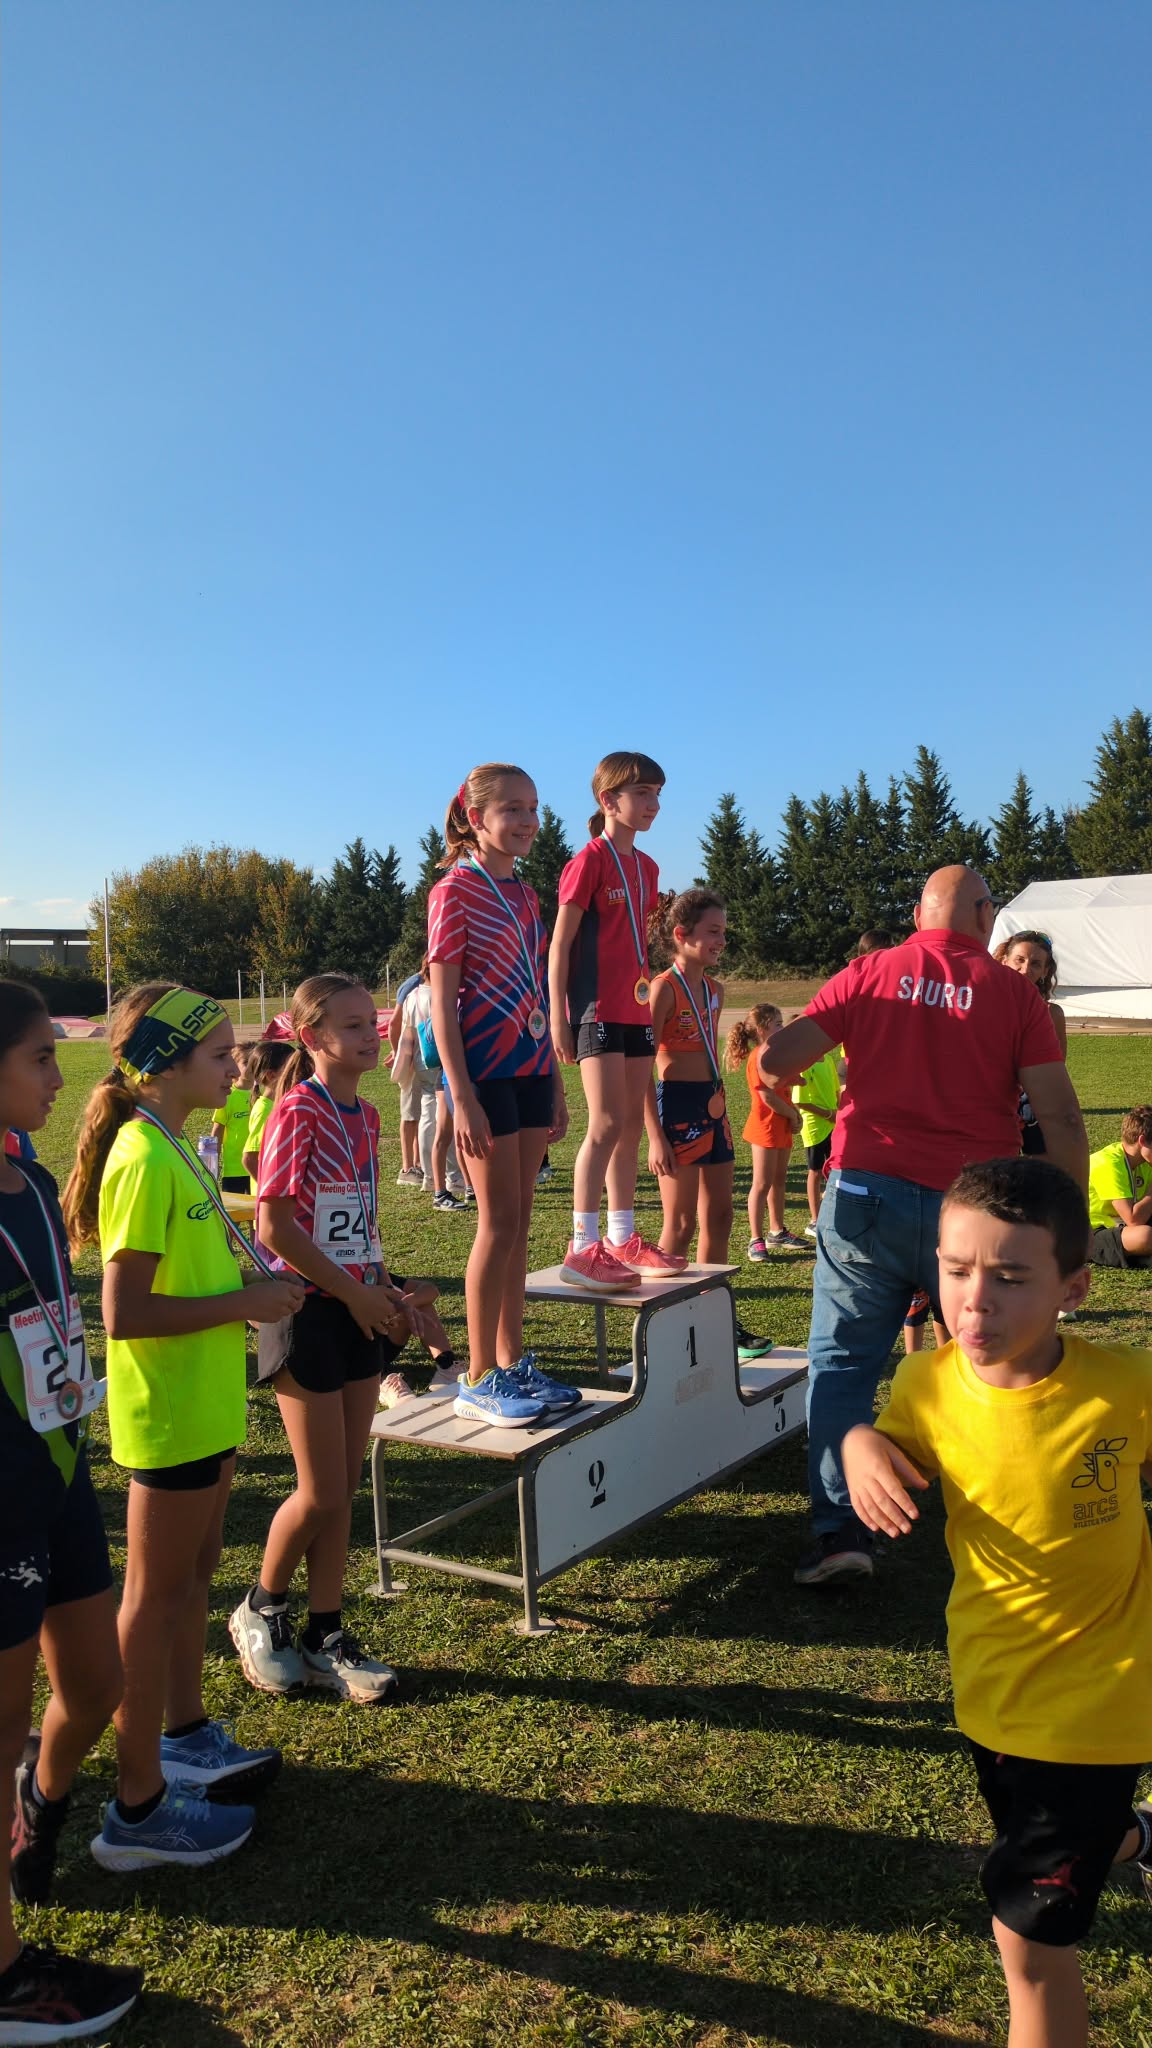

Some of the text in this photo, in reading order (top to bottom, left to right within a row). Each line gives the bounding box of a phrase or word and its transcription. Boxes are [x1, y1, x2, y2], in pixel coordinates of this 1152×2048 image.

[897, 975, 973, 1010] SAURO
[156, 1031, 188, 1057] LA
[319, 1183, 346, 1195] Meeting
[328, 1209, 373, 1242] 24
[14, 1308, 46, 1330] Meetin
[686, 1325, 698, 1368] 1
[588, 1460, 607, 1509] 2
[1073, 1493, 1119, 1520] arcs
